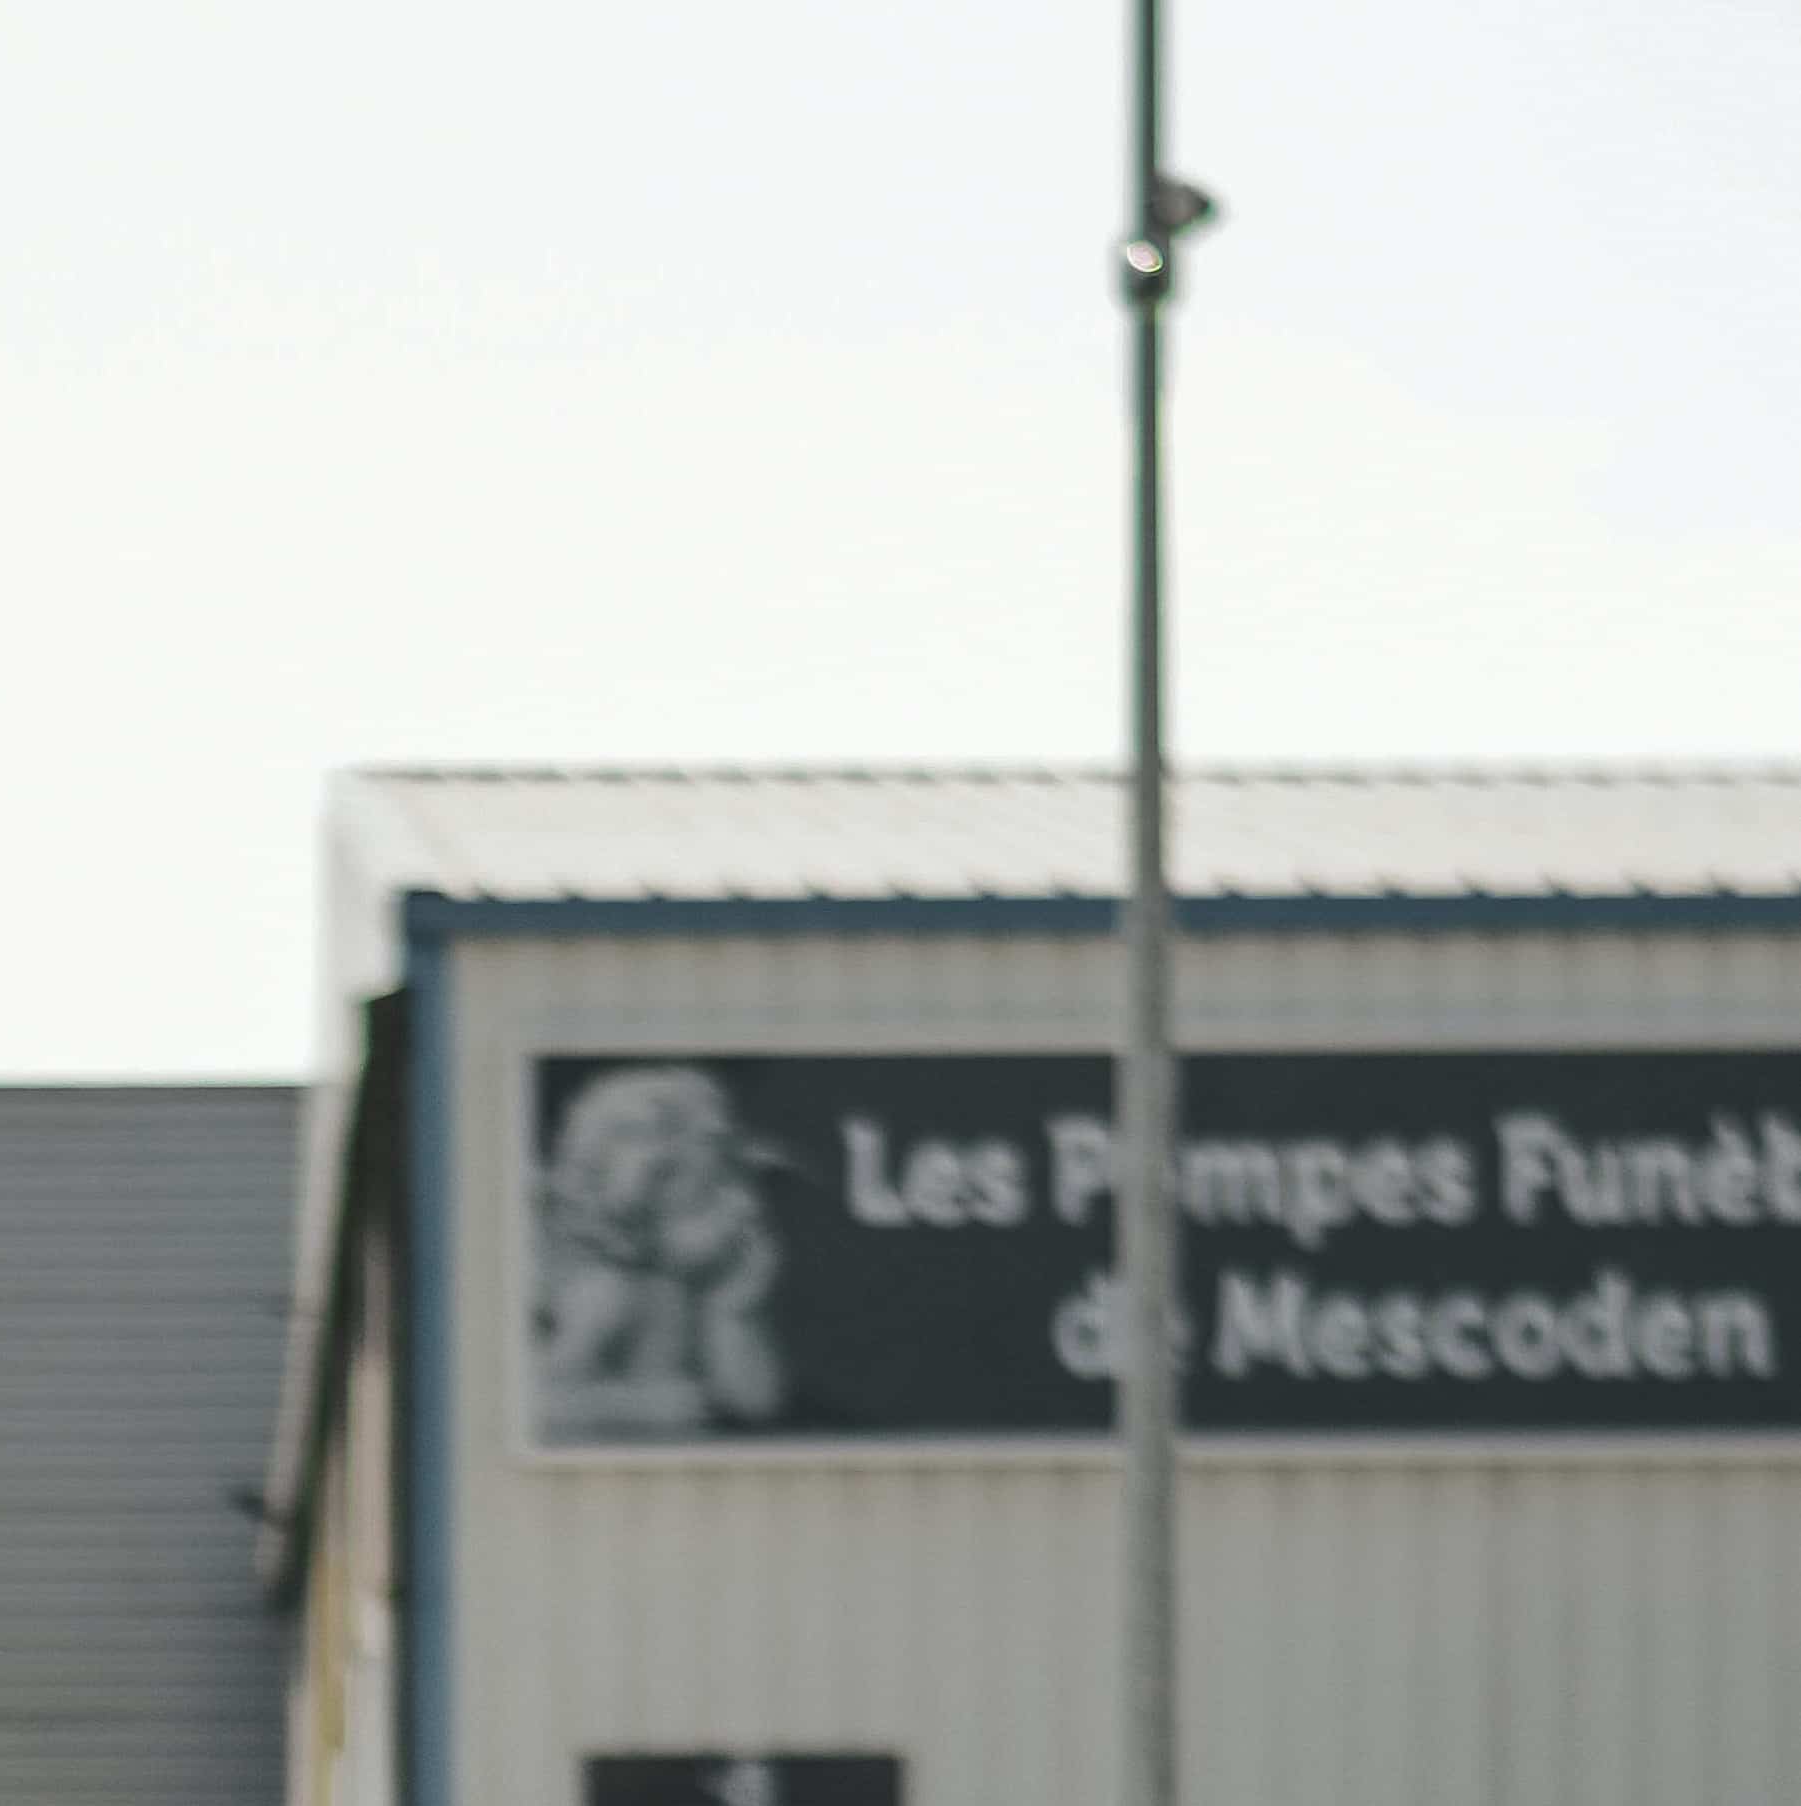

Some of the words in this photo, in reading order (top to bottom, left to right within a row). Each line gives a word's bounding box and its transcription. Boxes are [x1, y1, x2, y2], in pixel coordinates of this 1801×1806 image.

[846, 1115, 1026, 1227] Les
[1048, 1114, 1478, 1251] Pmpes
[1052, 1271, 1193, 1378] d
[1212, 1270, 1777, 1379] Mescoden
